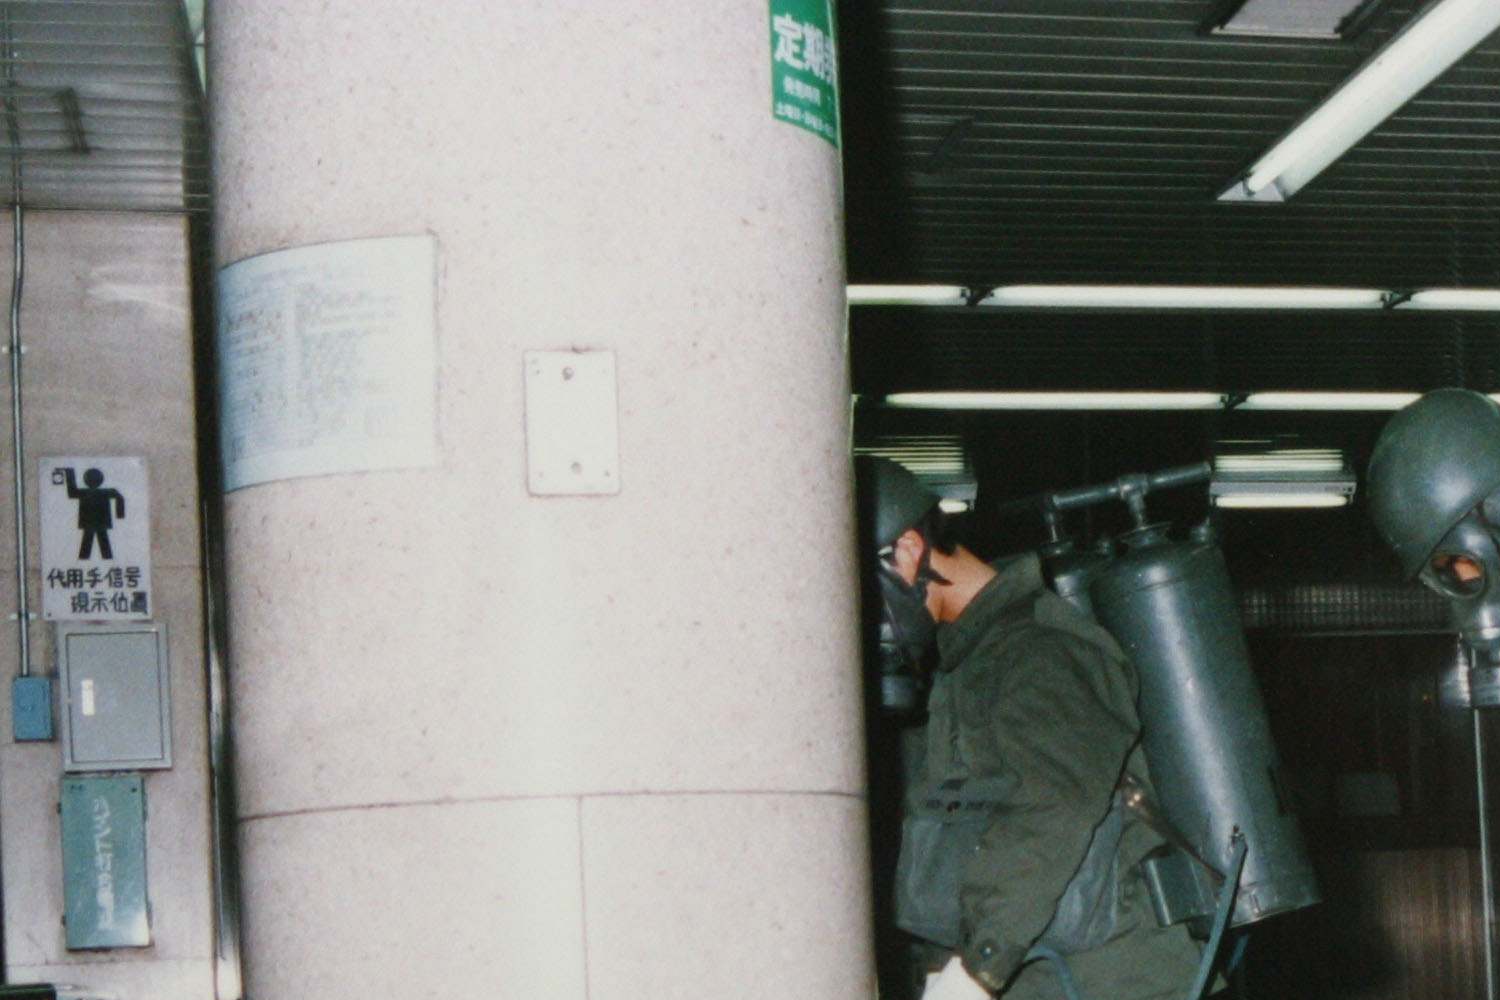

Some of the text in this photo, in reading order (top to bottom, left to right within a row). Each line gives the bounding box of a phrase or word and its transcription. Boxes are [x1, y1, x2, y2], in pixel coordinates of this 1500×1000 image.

[46, 566, 142, 590] 代用手信号
